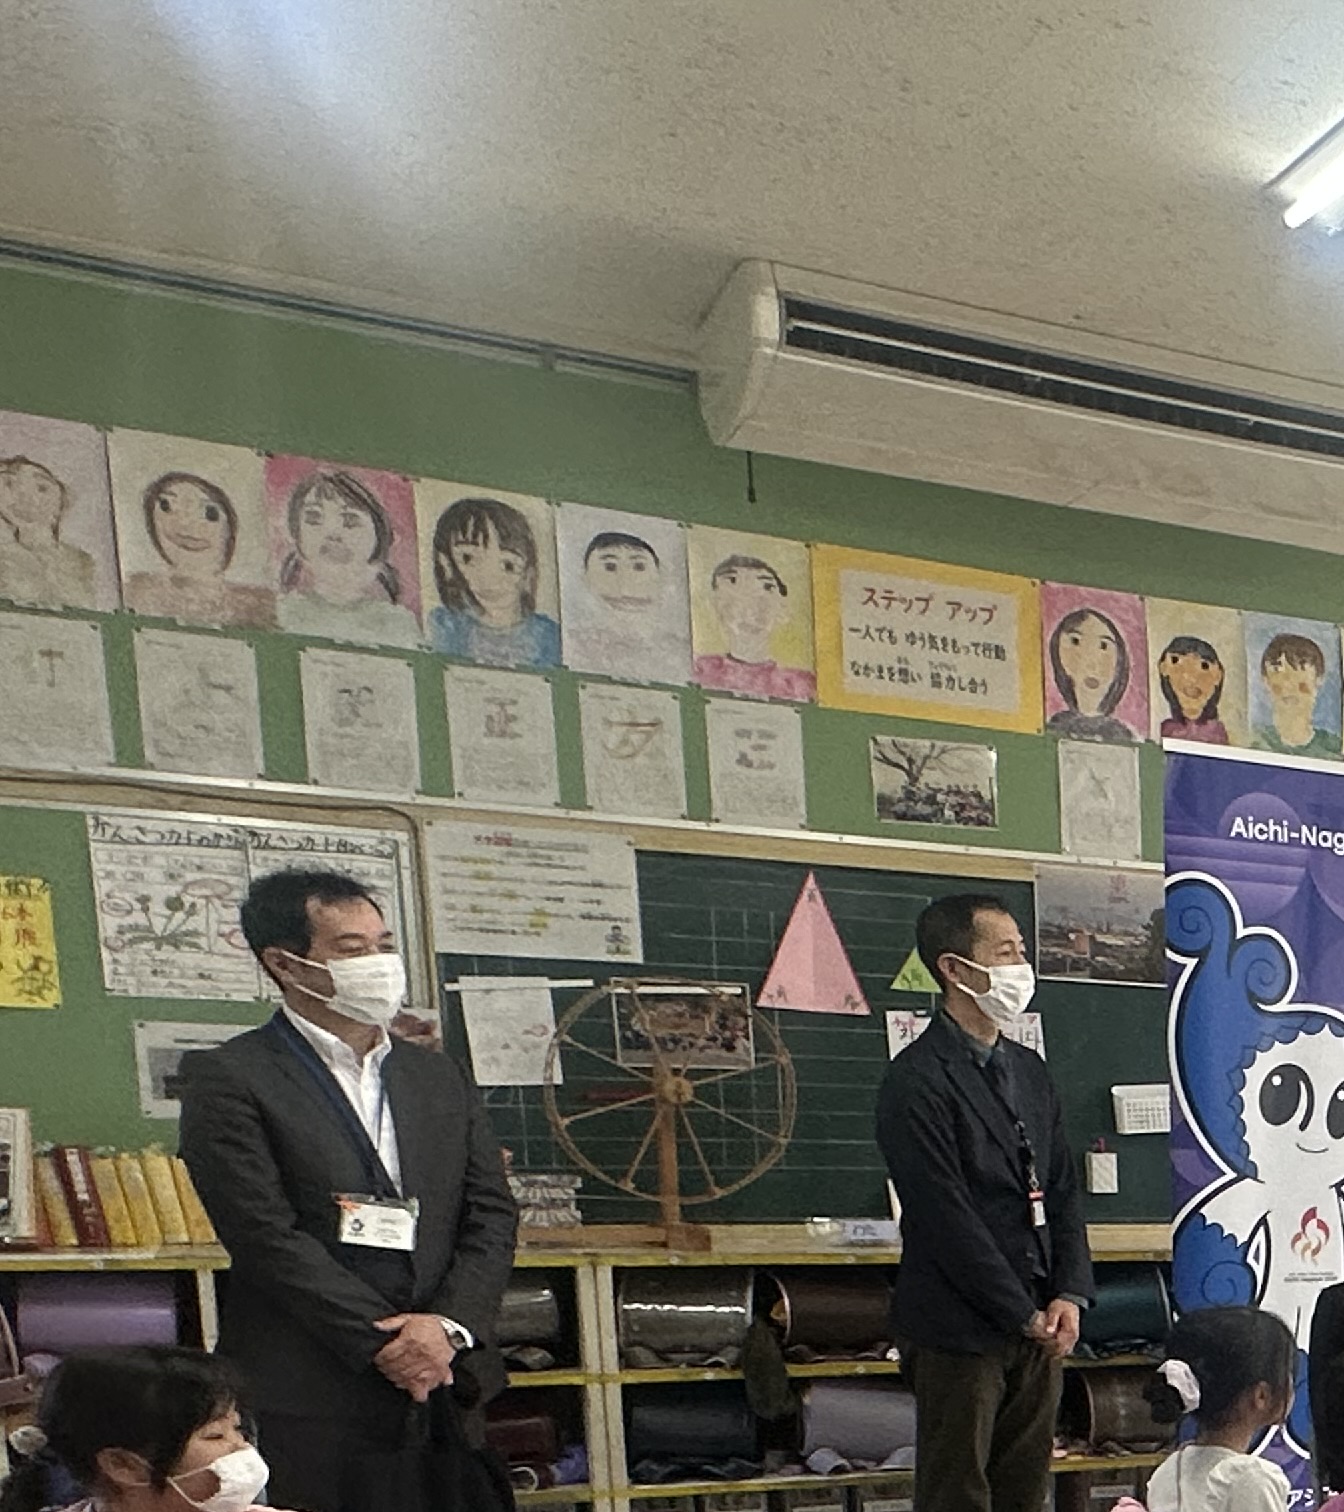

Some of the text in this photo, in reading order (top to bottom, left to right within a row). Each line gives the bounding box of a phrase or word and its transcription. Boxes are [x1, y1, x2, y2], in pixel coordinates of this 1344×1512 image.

[862, 586, 998, 626] ステップ アップ
[848, 624, 898, 646] 一人でも
